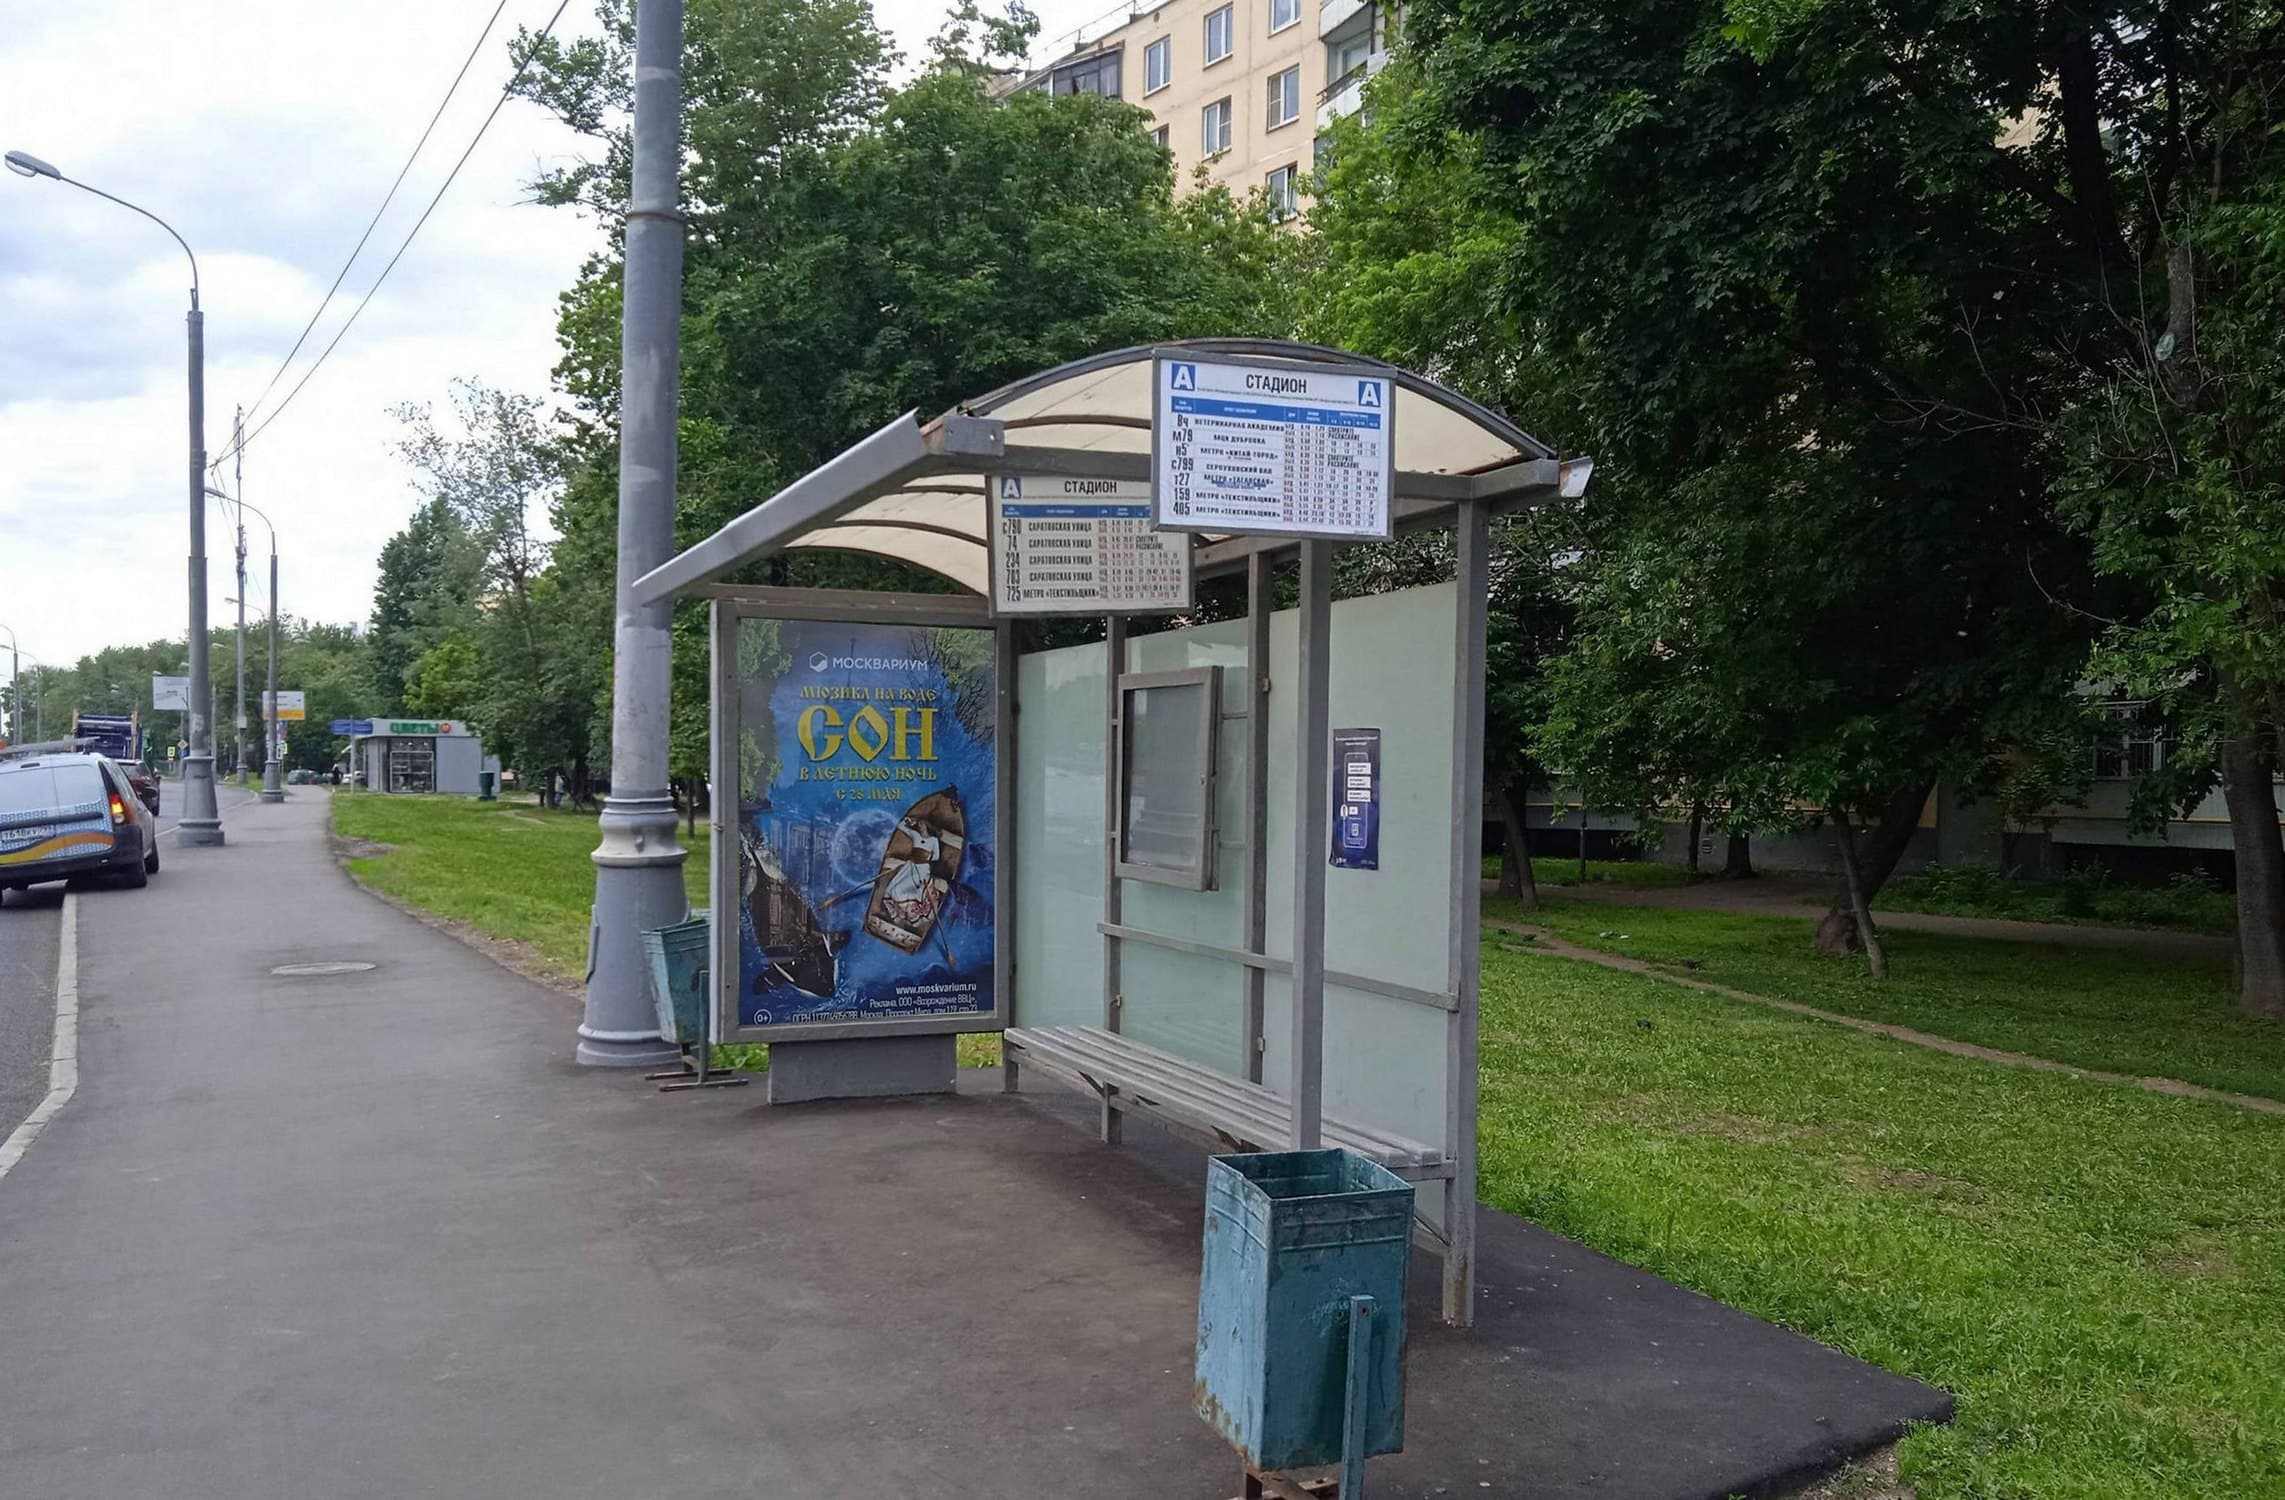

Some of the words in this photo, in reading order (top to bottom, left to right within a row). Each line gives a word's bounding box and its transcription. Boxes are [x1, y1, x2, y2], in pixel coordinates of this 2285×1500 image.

[1173, 366, 1194, 389] А
[1246, 374, 1307, 394] СТАДИОН
[1360, 383, 1380, 405] А
[1200, 447, 1224, 455] МЕТРО
[1064, 481, 1117, 495] СТАДИОН
[1174, 487, 1190, 501] 159
[1196, 491, 1219, 500] МЕТРО
[1173, 501, 1190, 516] 405
[1196, 506, 1219, 514] МЕТРО
[832, 657, 928, 671] МОСКВАРИУМ
[874, 687, 895, 701] НА
[898, 687, 937, 702] ВОДЕ
[797, 704, 939, 762] СОН
[800, 767, 809, 781] В
[813, 766, 890, 781] ЛЕТНЮЮ
[894, 767, 937, 781] НОЧЬ
[836, 788, 846, 800] С
[868, 787, 901, 801] МАЯ
[896, 982, 977, 995] www.moskvarium.ru
[898, 996, 912, 1006] ООО
